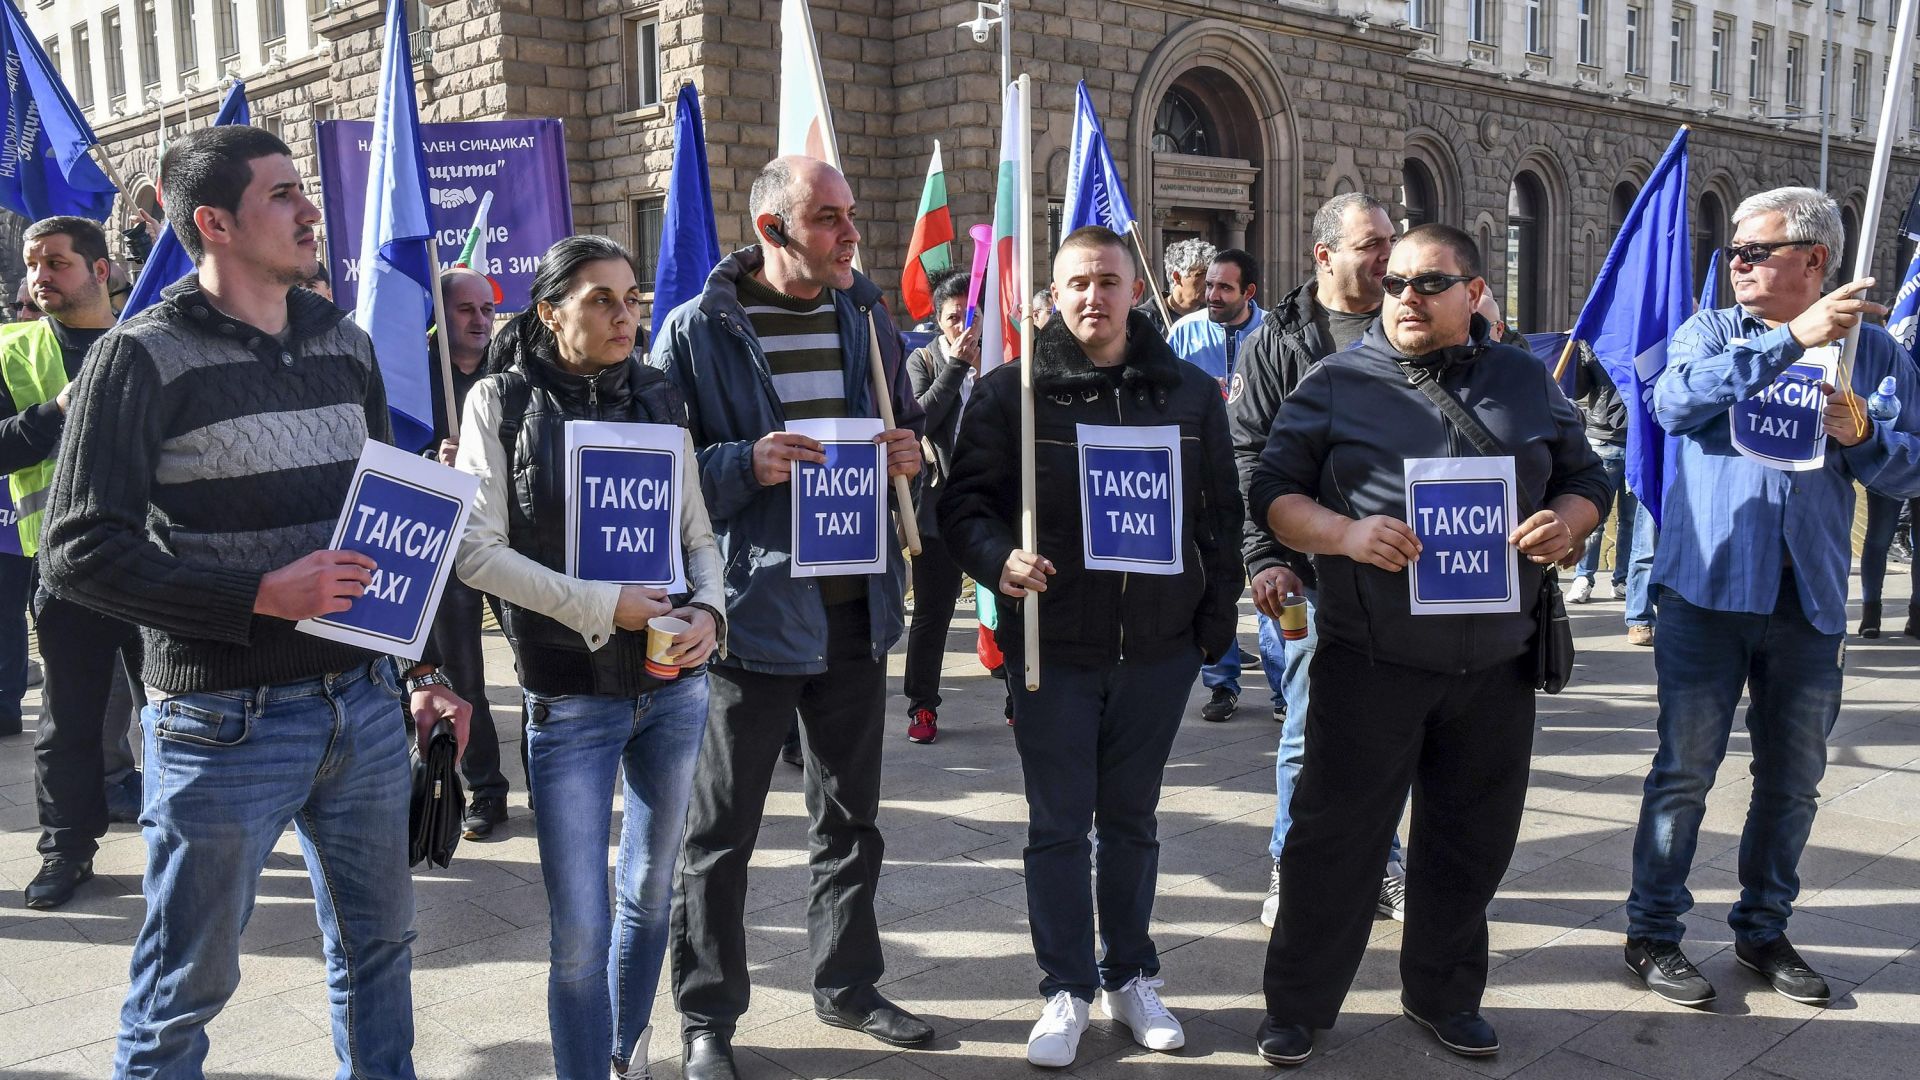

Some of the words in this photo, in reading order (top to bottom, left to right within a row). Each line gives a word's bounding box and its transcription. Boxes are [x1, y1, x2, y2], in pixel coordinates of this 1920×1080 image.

[460, 136, 535, 152] СИНДИКАТ
[1748, 381, 1818, 410] АКСИ
[1747, 412, 1799, 439] TAXI
[585, 476, 669, 511] ТАКСИ
[802, 467, 874, 497] ТАКСИ
[1089, 469, 1168, 500] ТАКСИ
[354, 503, 446, 563] ТАКСИ
[815, 512, 861, 536] TAXI
[1106, 511, 1155, 536] TAXI
[1418, 505, 1503, 536] ТАКСИ
[601, 526, 655, 553] TAXI
[1435, 550, 1489, 575] TAXI
[363, 568, 412, 605] AXI
